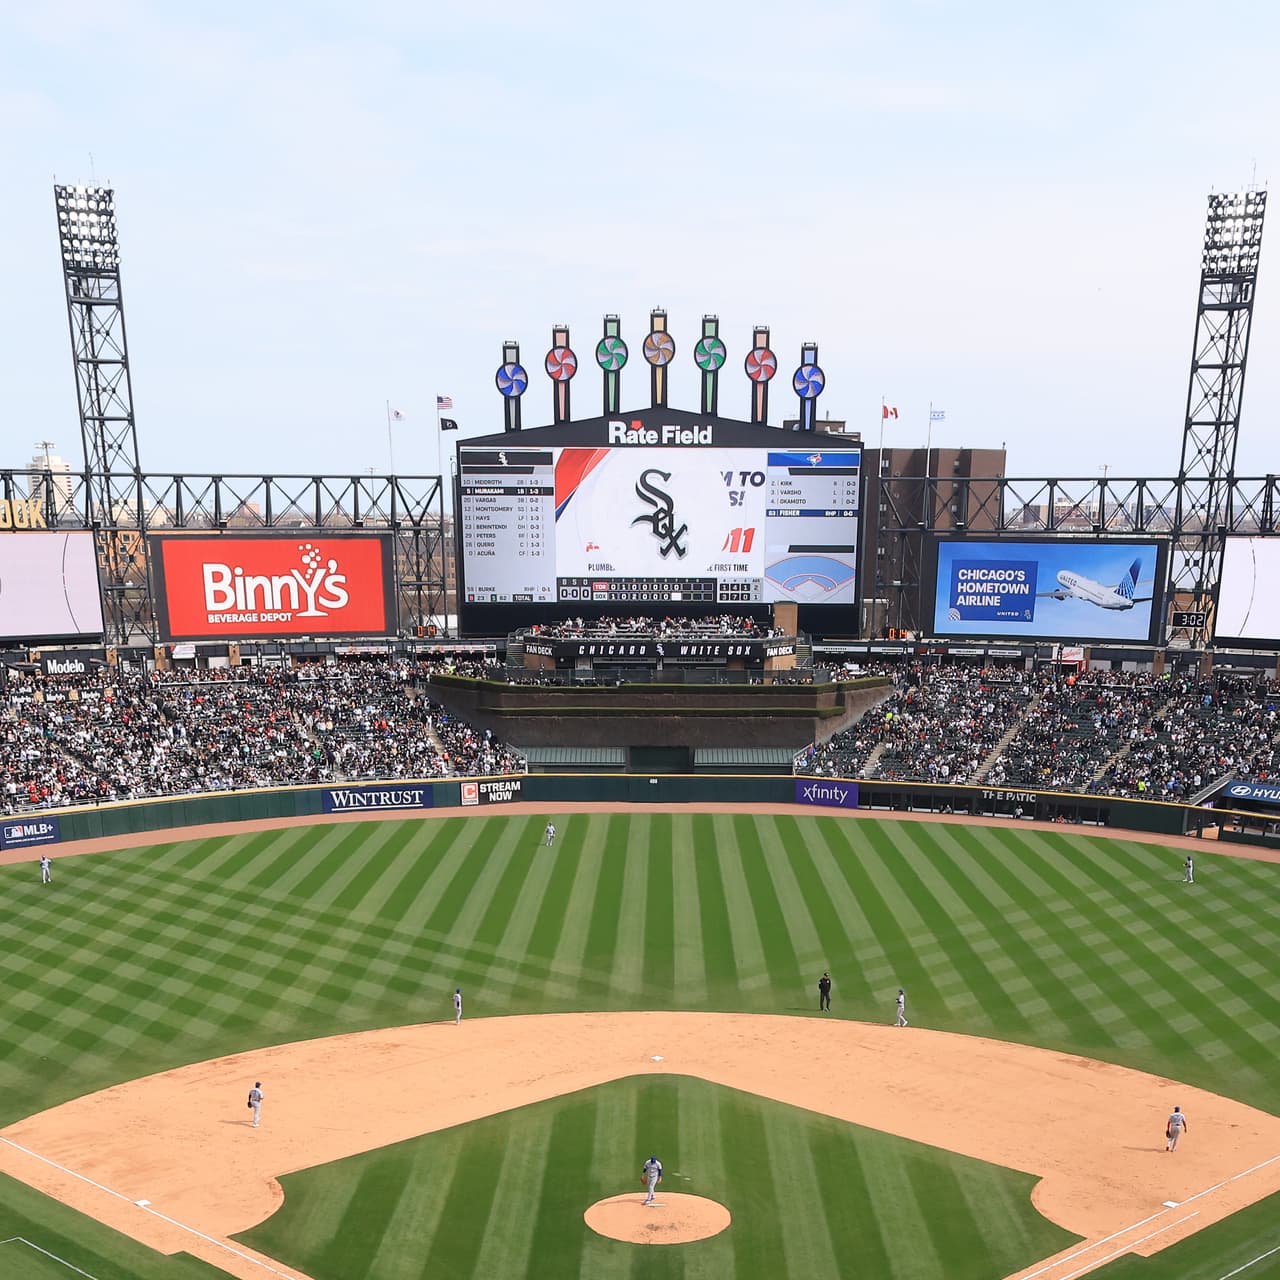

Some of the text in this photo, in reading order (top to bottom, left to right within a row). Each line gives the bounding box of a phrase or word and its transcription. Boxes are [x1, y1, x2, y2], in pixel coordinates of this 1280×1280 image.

[609, 421, 713, 444] Rate Field
[740, 472, 766, 487] TO
[714, 564, 748, 572] FIRST TIME
[958, 569, 1025, 582] CHICAGO'S
[1060, 574, 1078, 588] UNITED
[958, 582, 1030, 594] HOMETOWN
[956, 595, 1000, 606] AIRLINE
[208, 612, 292, 624] BEVERAGE DEPOT
[1182, 614, 1204, 626] 3:02
[526, 645, 552, 656] FAN DECK
[578, 646, 752, 655] CHICAGO WHITE SOX
[766, 646, 792, 657] FAN DECK
[47, 660, 84, 674] Modelo
[480, 782, 520, 793] STREAM
[330, 790, 424, 808] WINTRUST
[490, 792, 512, 802] NOW
[802, 784, 848, 804] xfinity
[982, 790, 1004, 801] THE
[24, 824, 54, 836] MLB+
